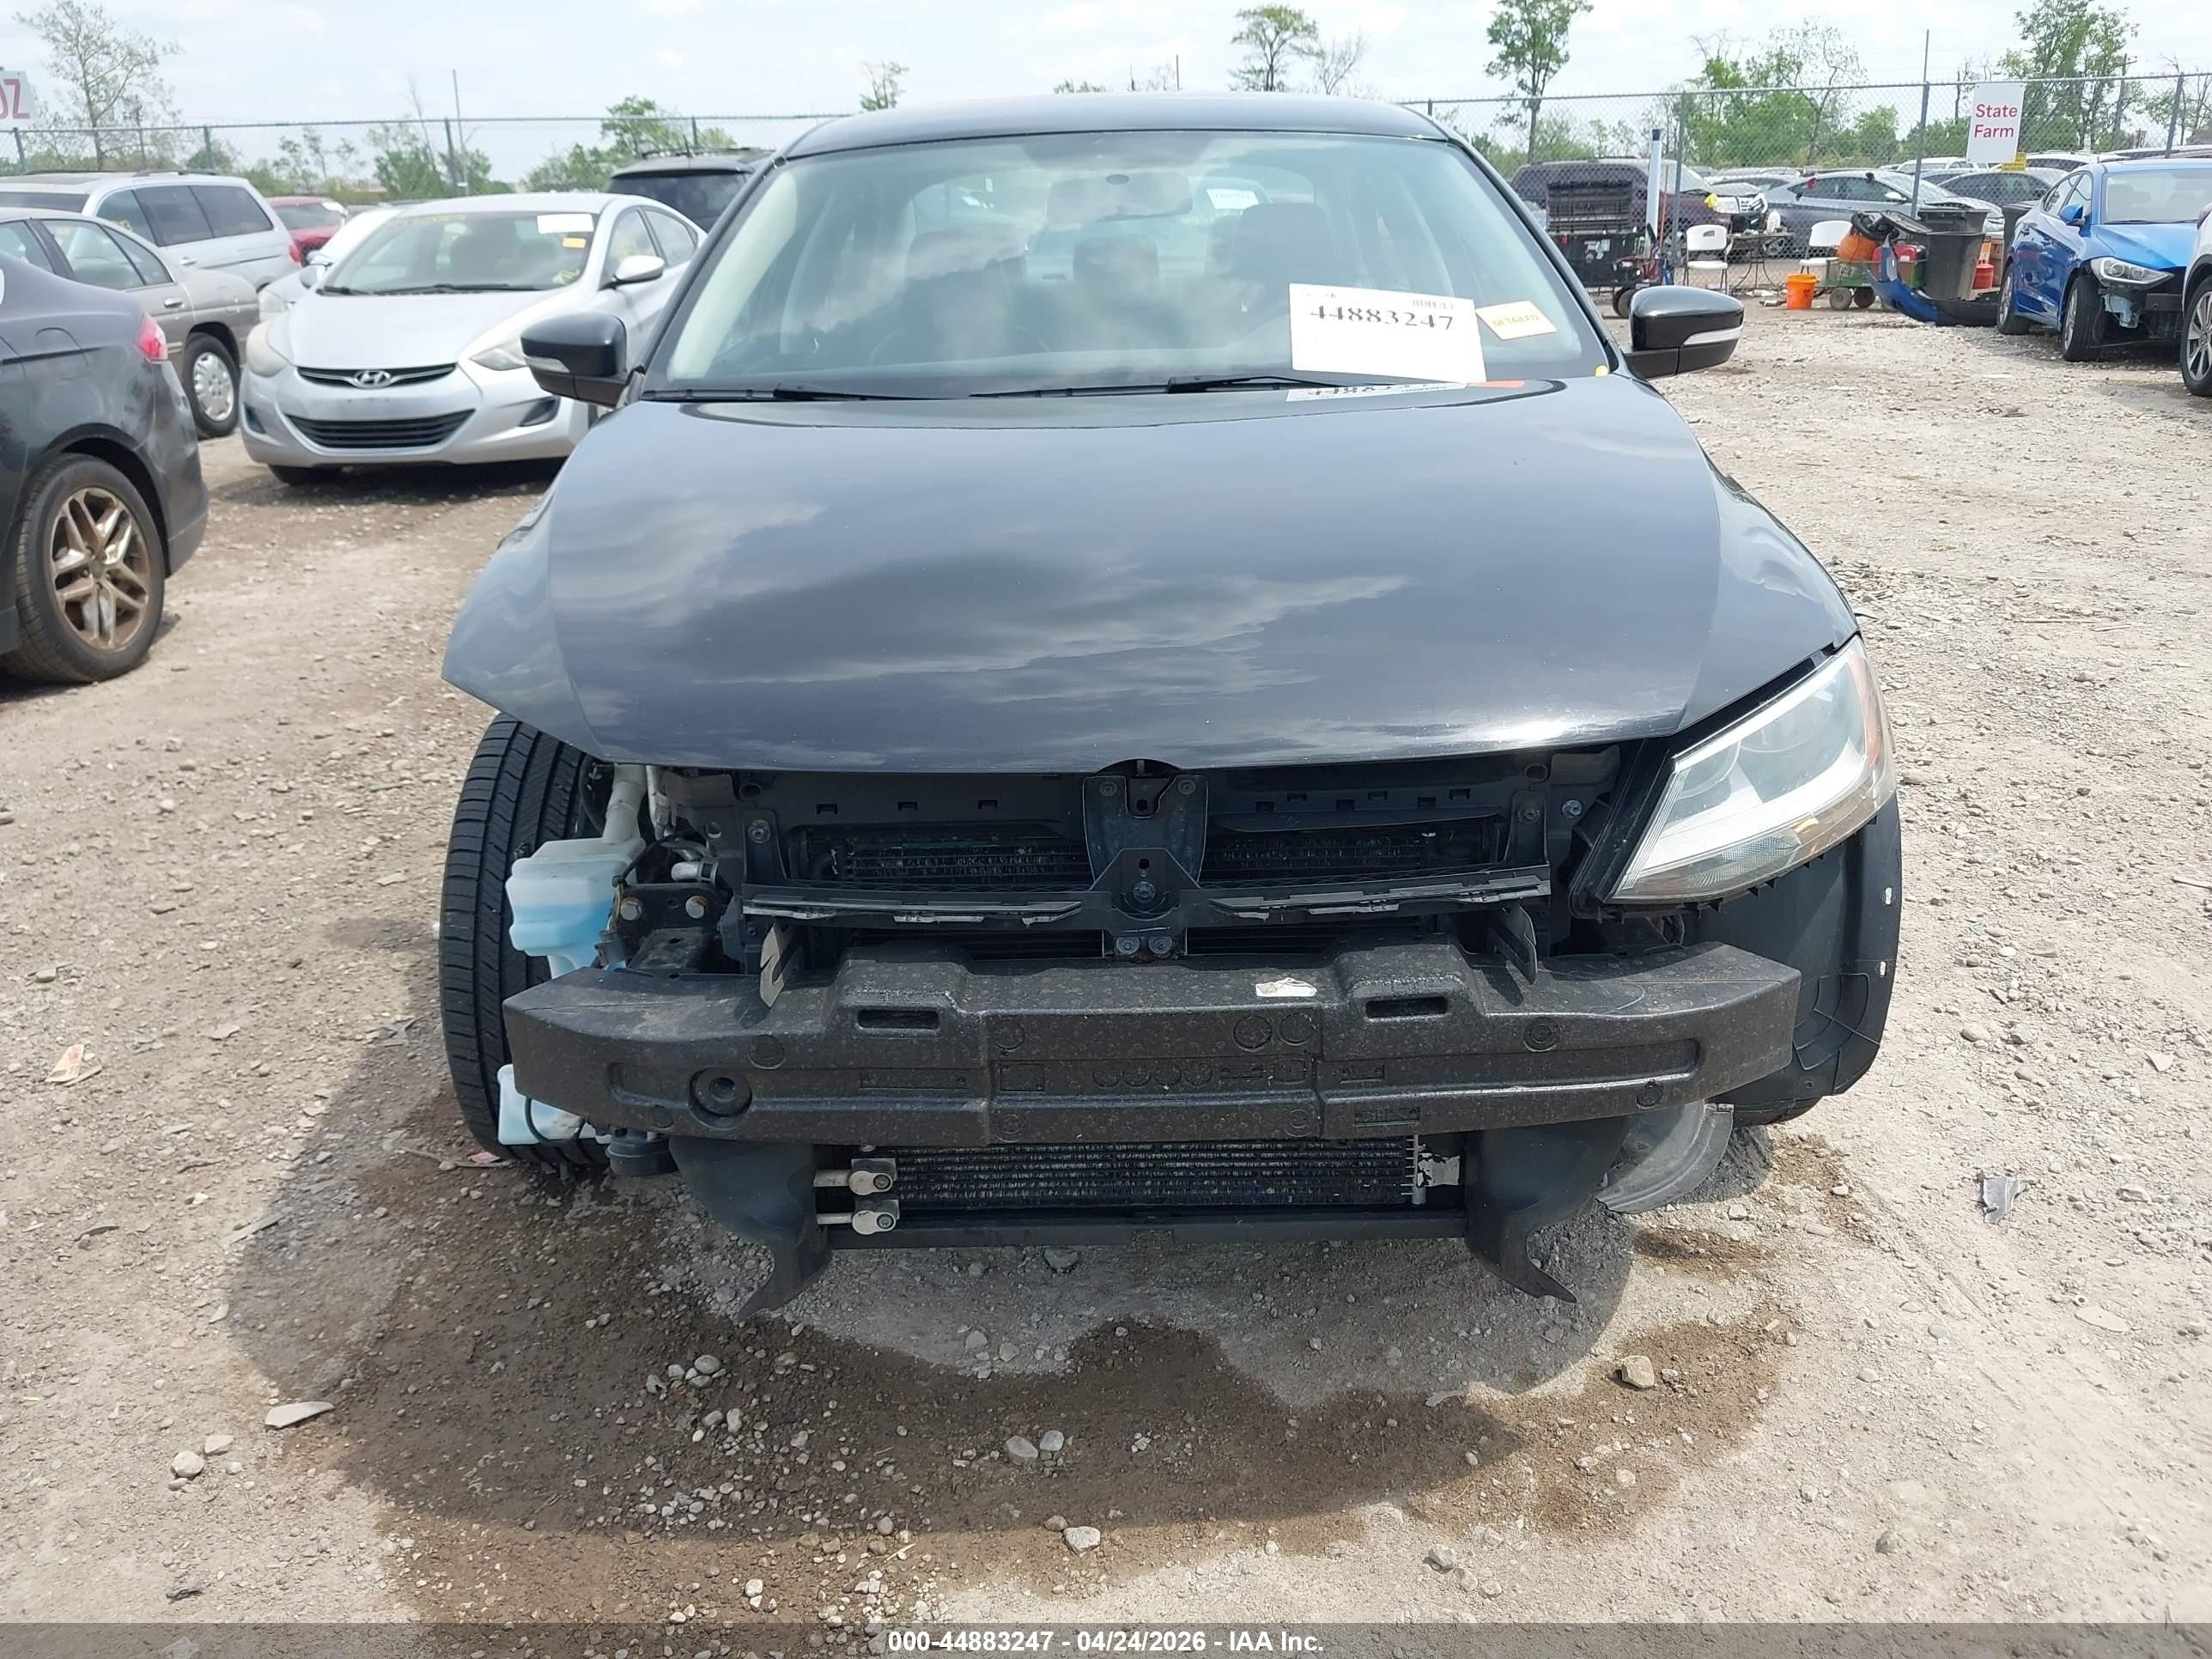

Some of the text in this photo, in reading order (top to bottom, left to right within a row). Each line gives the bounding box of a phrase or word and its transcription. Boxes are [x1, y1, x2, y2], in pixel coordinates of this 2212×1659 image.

[1976, 103, 2018, 118] State
[1974, 124, 2014, 138] Farm
[1310, 304, 1455, 331] 44883247
